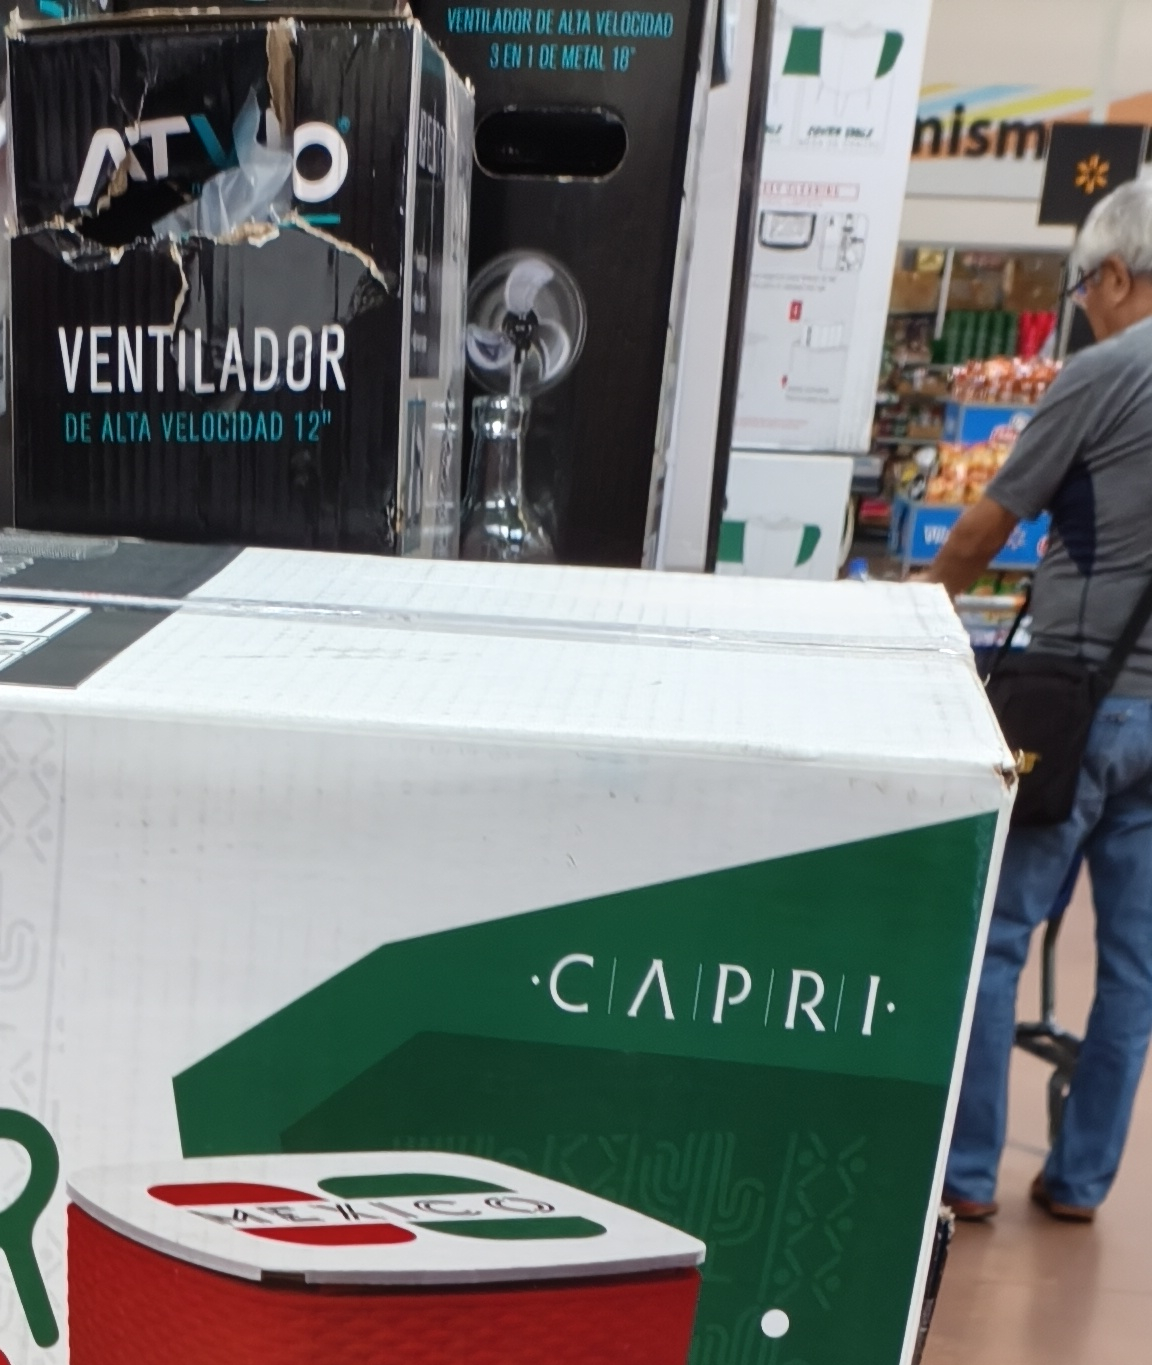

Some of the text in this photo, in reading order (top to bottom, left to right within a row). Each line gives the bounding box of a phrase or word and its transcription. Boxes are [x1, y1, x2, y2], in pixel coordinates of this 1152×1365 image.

[448, 8, 674, 38] VENTILADOR DE ALTA VELOCIDAD
[503, 42, 605, 71] EN DE METAL
[58, 325, 346, 394] VENTILADOR
[65, 412, 91, 443] DE
[101, 412, 151, 443] ALTA
[161, 411, 283, 443] VELOCIDAD
